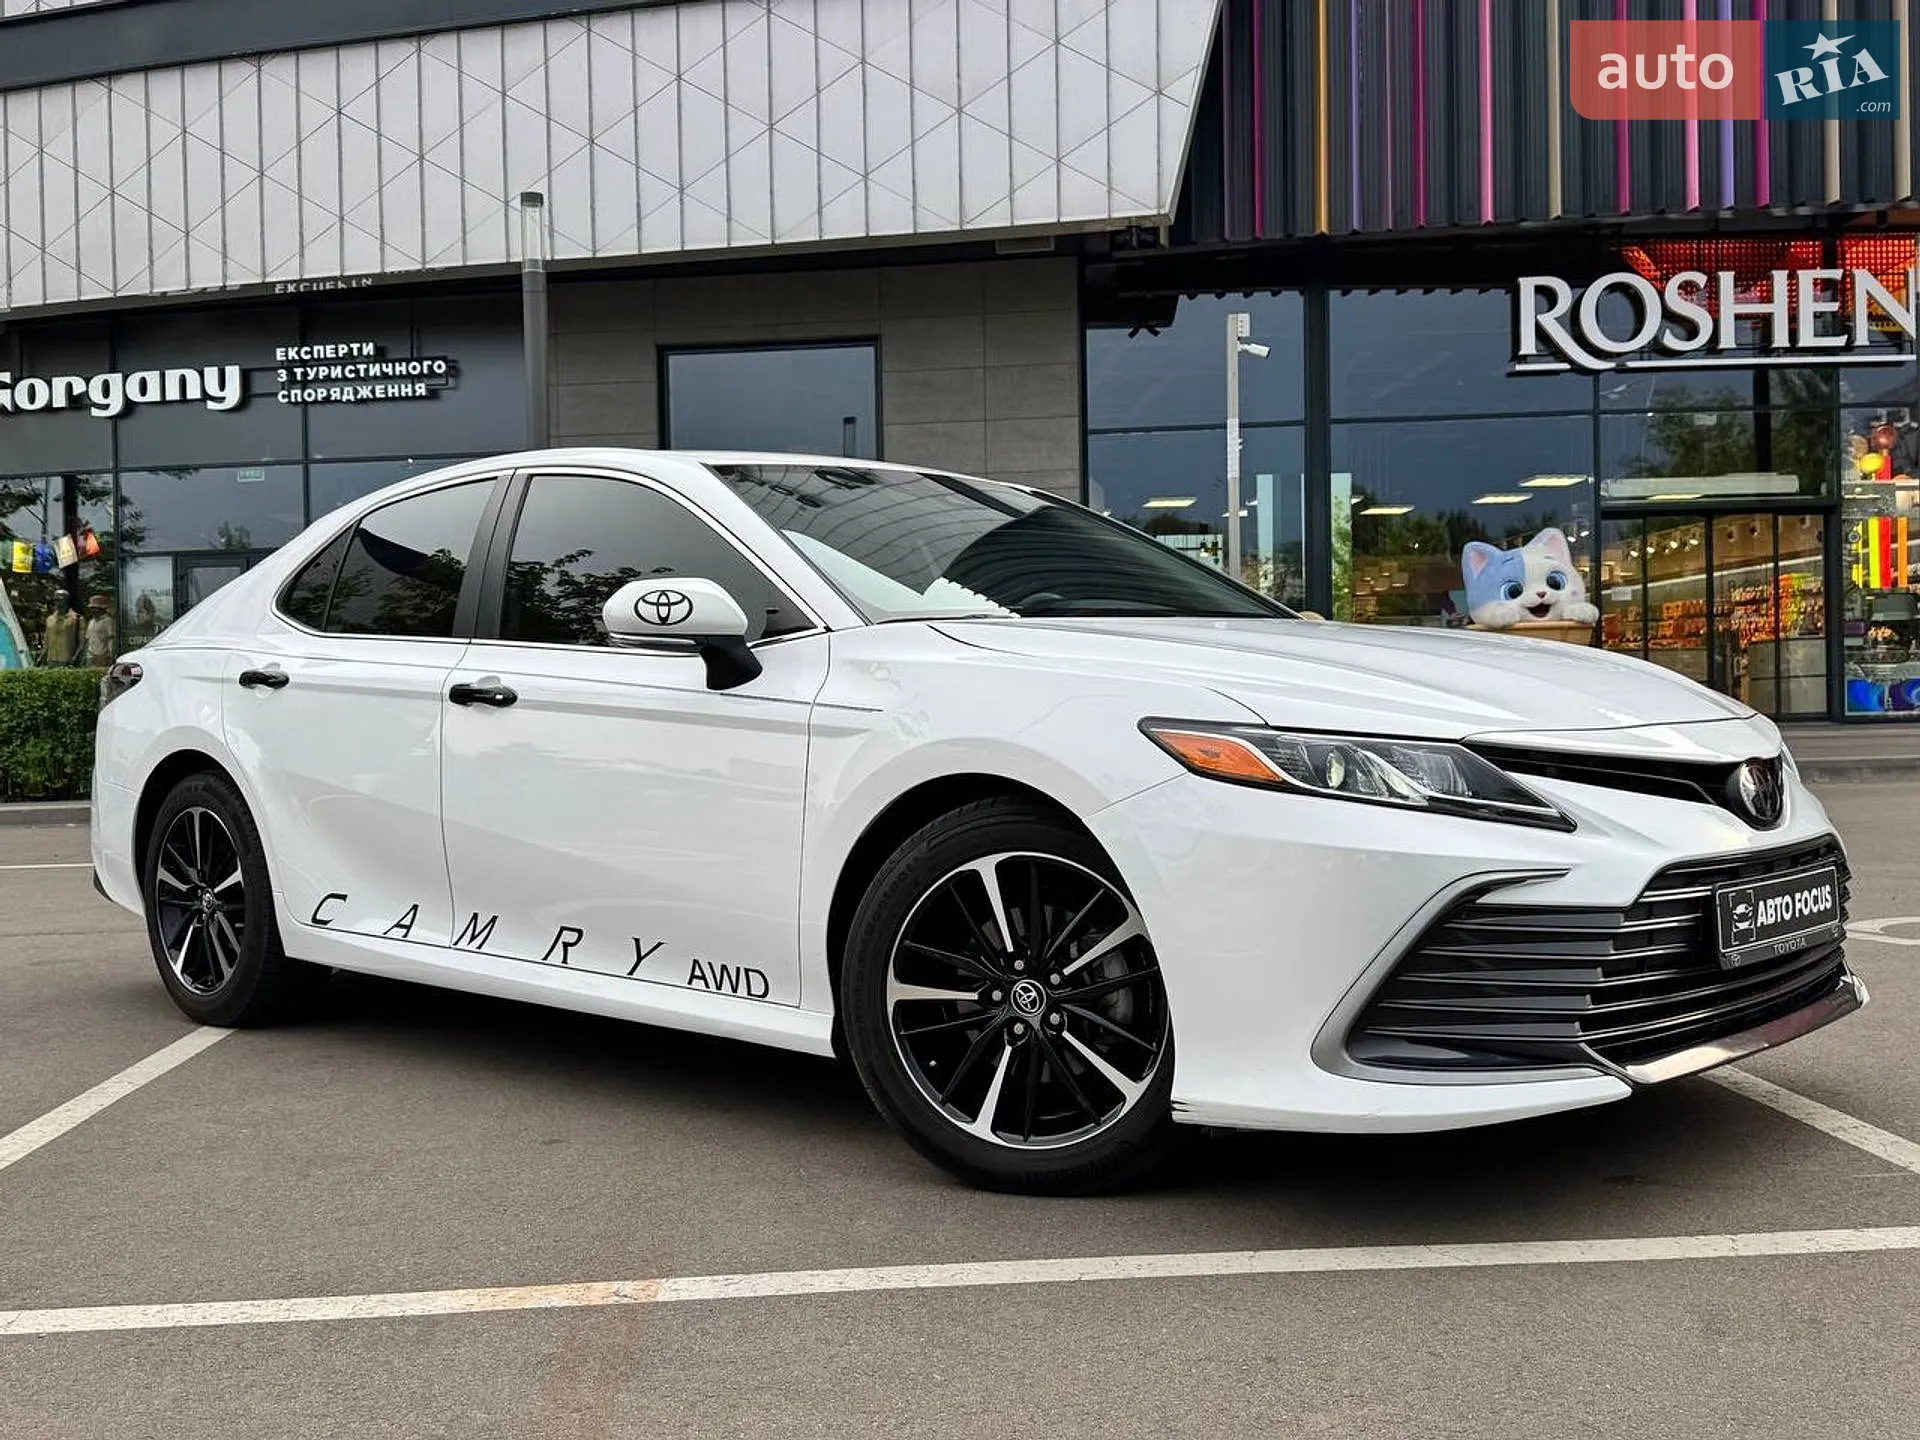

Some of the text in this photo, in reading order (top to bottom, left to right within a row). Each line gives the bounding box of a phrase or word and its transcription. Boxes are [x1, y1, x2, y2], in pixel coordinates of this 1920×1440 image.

[1516, 267, 1917, 371] ROSHEN
[275, 341, 375, 361] ЕКСПЕРТИ
[293, 360, 447, 381] ТУРИСТИЧНОГО
[277, 383, 427, 403] СПОРЯДЖЕННЯ
[1795, 884, 1832, 918] FOCUS
[1773, 938, 1808, 956] TOYOTA
[687, 958, 770, 999] AWD
